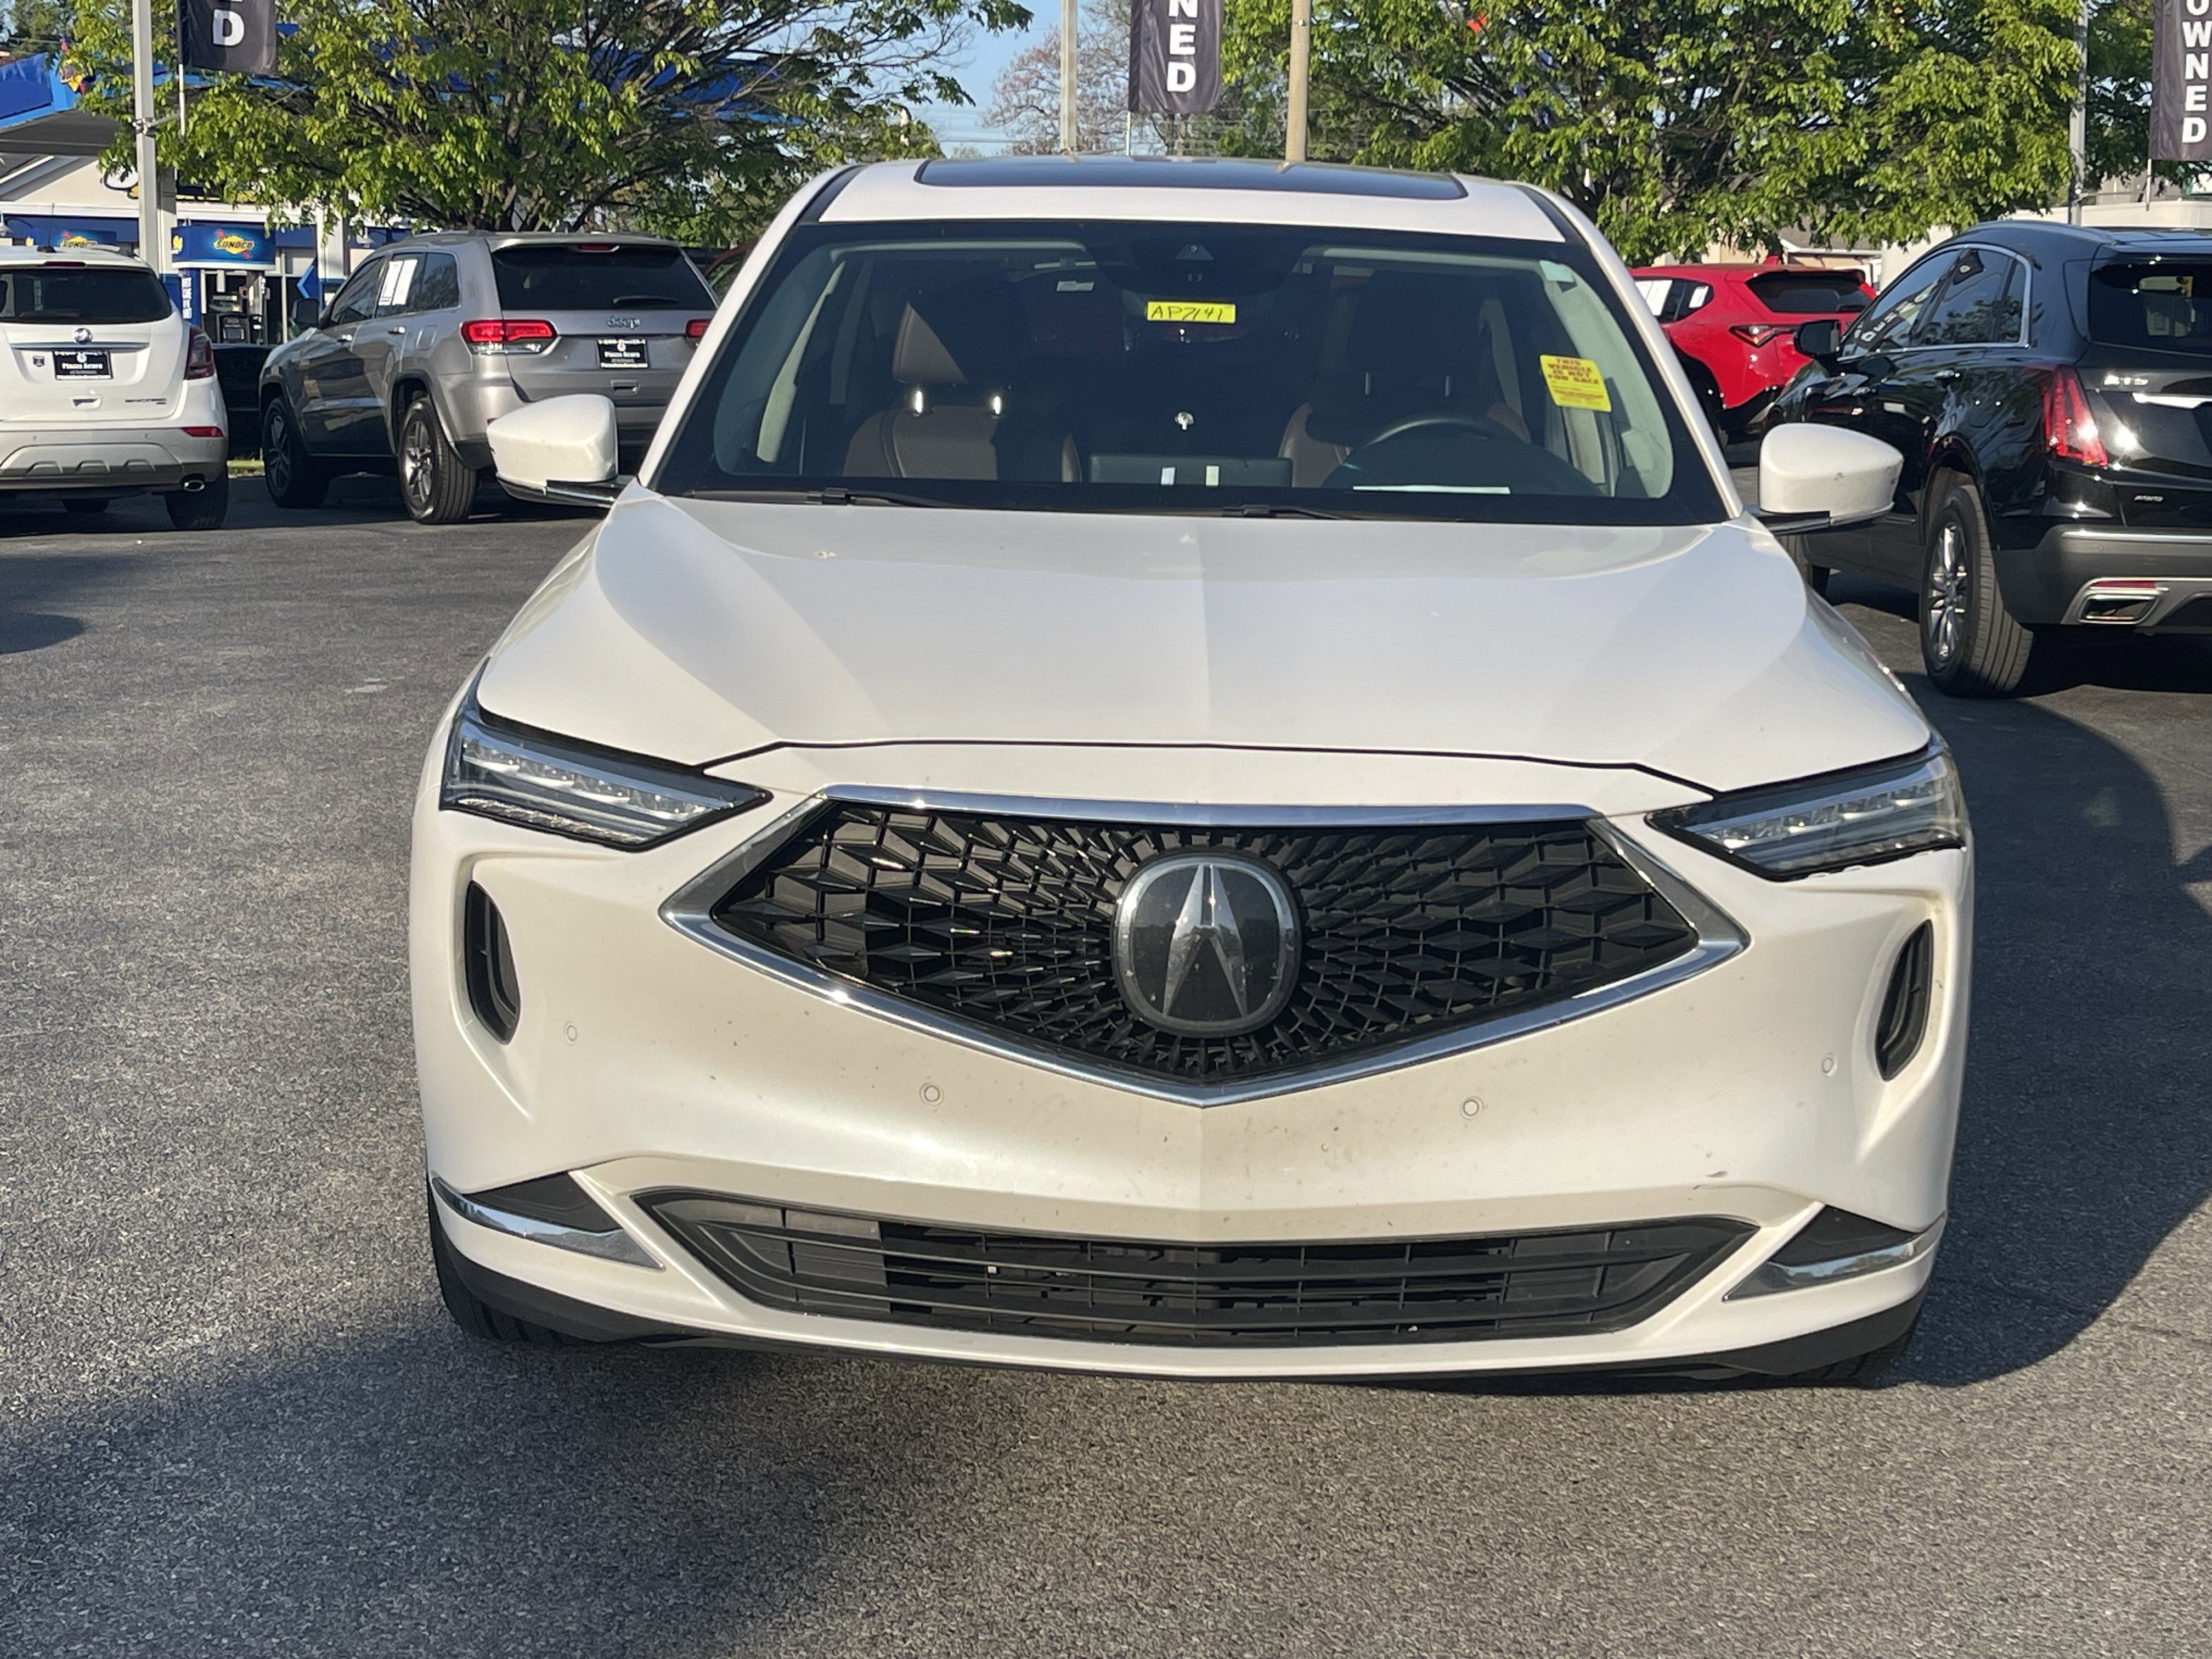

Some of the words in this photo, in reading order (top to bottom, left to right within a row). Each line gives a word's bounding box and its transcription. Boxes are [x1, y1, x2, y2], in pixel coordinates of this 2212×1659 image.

[213, 0, 244, 46] D
[2182, 0, 2212, 144] OWNED
[1150, 305, 1223, 321] AP7141
